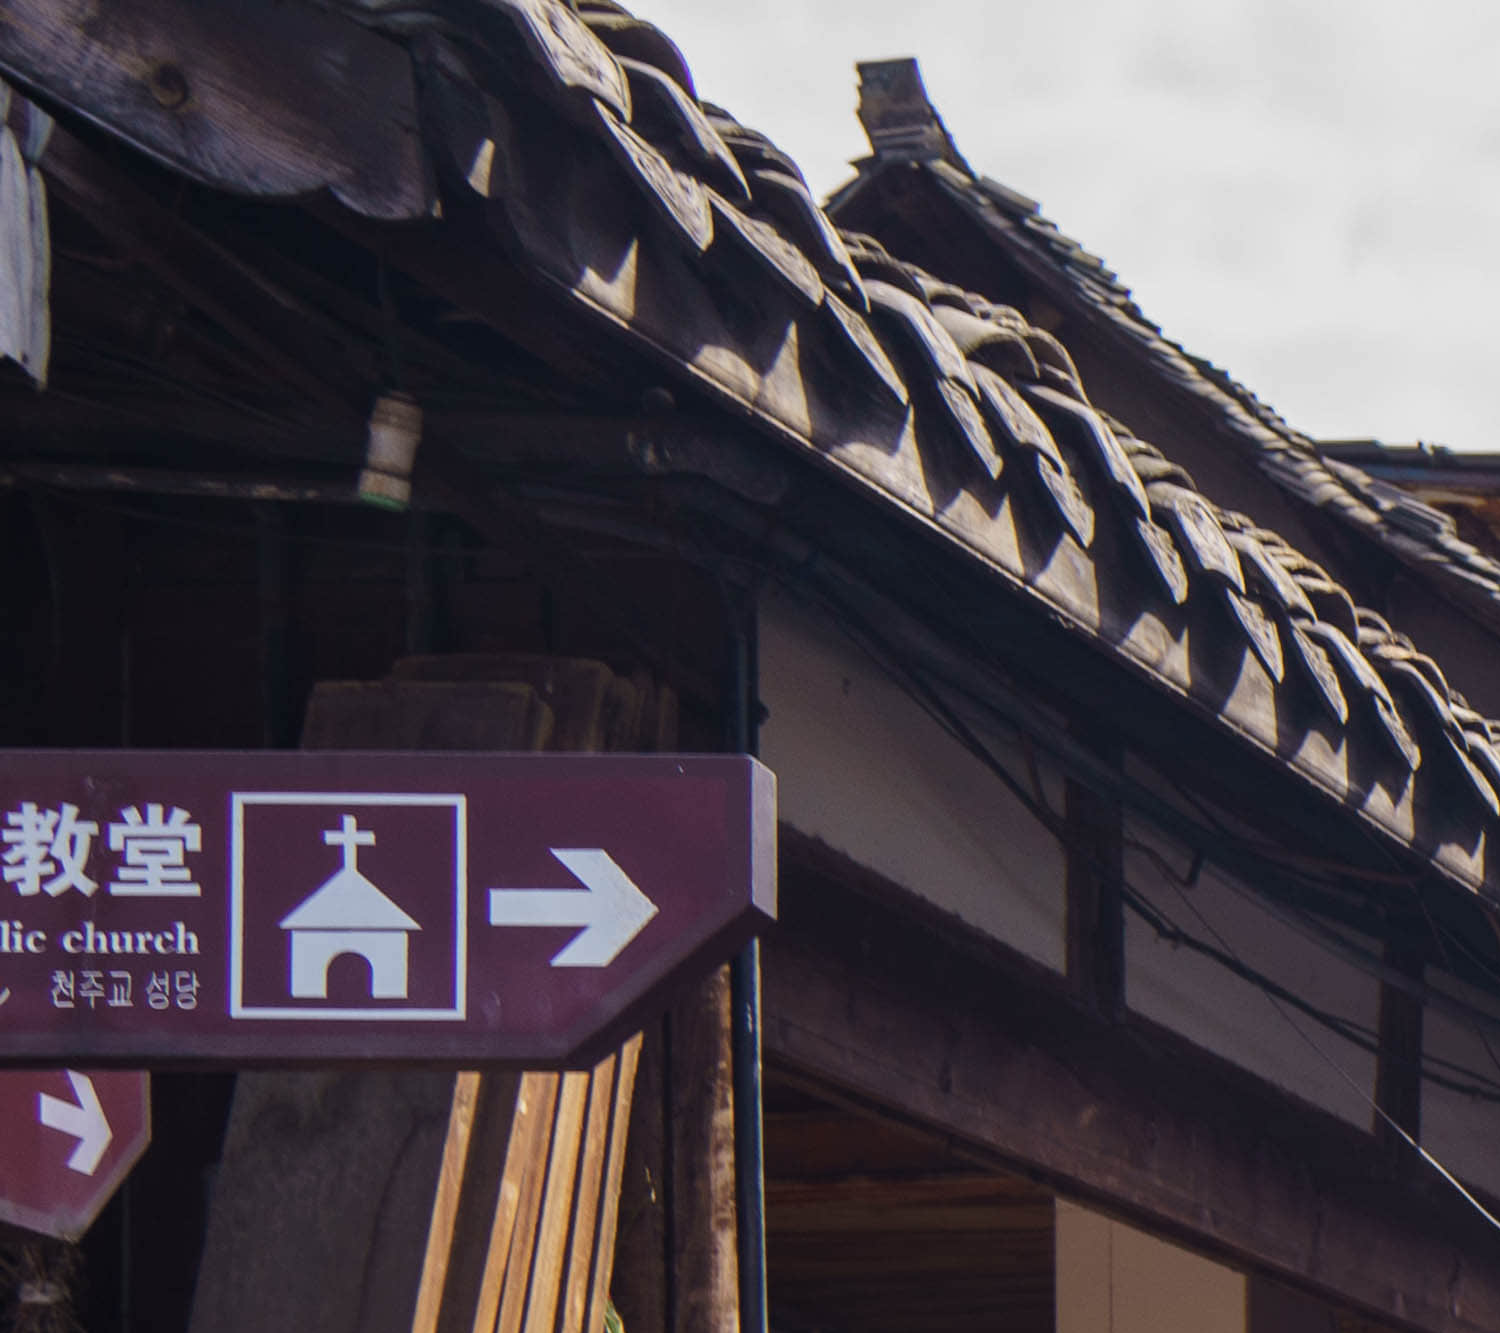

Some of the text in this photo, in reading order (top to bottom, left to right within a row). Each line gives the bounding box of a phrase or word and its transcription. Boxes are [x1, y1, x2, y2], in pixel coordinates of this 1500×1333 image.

[1, 801, 202, 898] 教堂
[60, 920, 200, 954] church
[51, 969, 200, 1010] 천주교 성당
